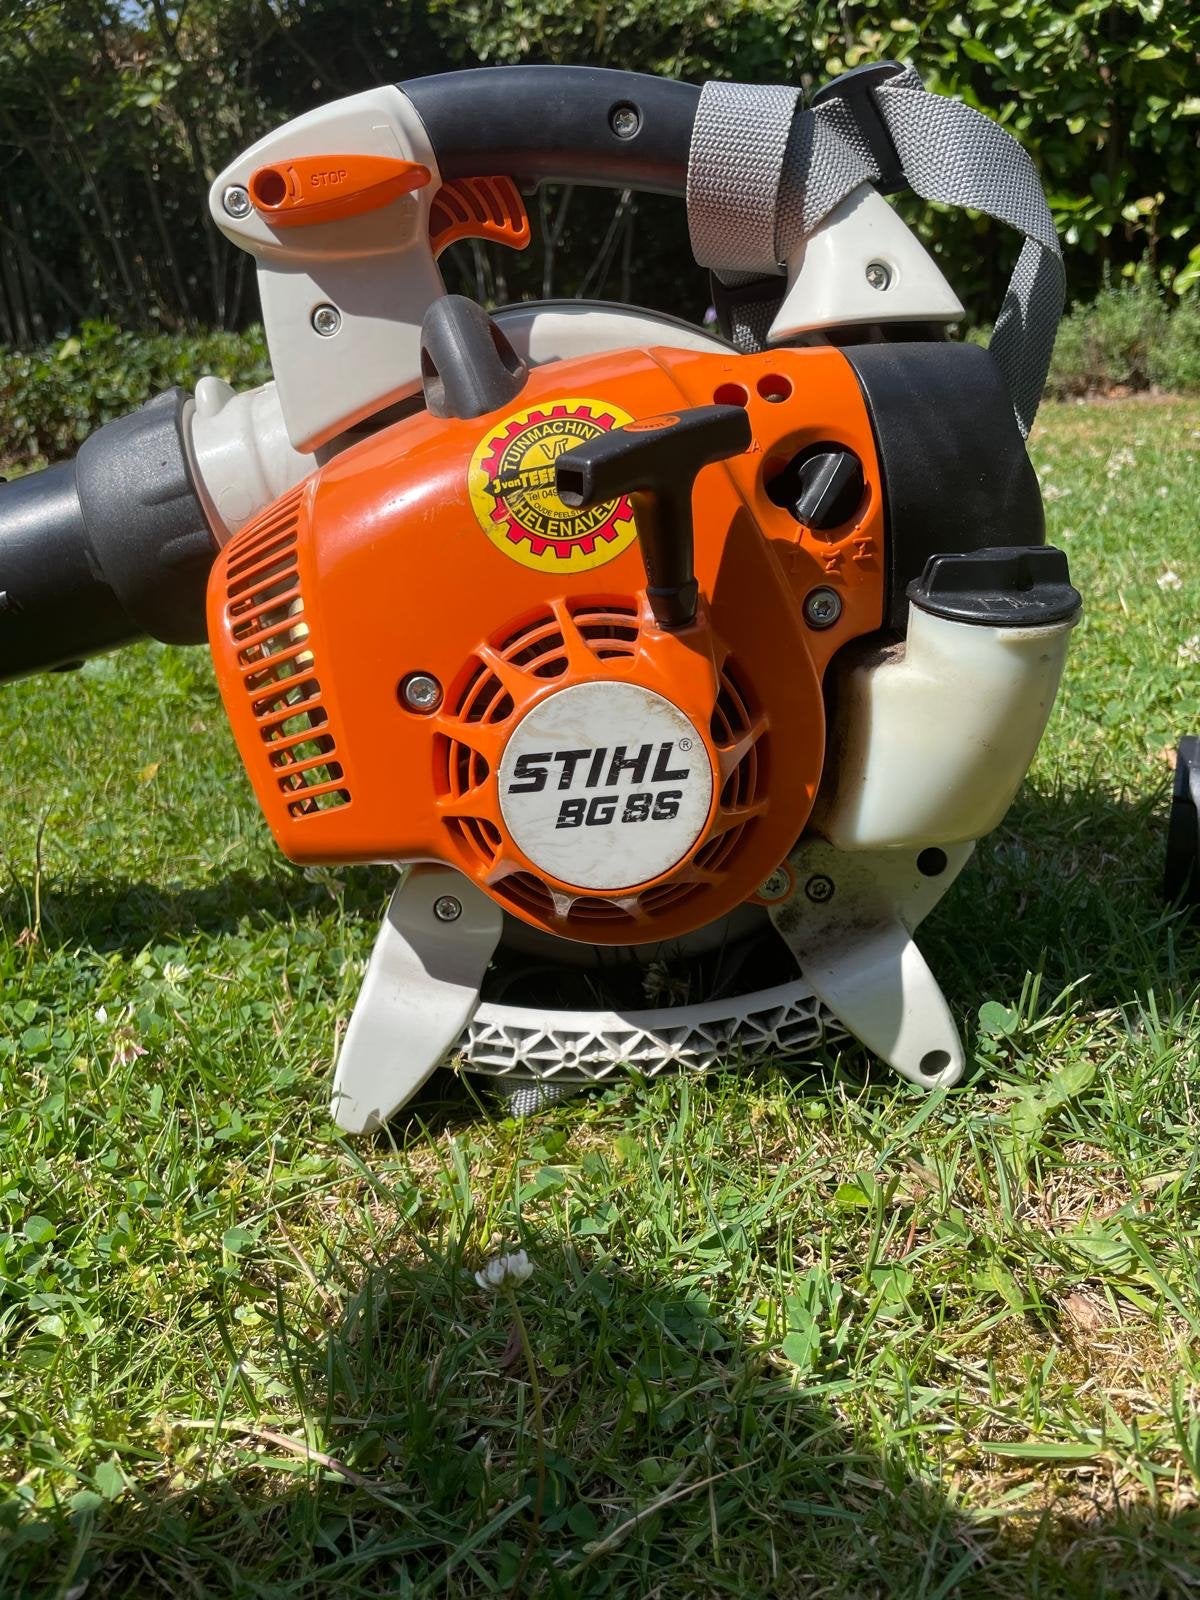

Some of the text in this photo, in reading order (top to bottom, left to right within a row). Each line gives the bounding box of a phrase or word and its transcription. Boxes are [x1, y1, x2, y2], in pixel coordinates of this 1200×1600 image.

[311, 169, 348, 188] STOP
[501, 478, 522, 489] van
[526, 491, 541, 502] Tel
[555, 790, 683, 830] BG 86
